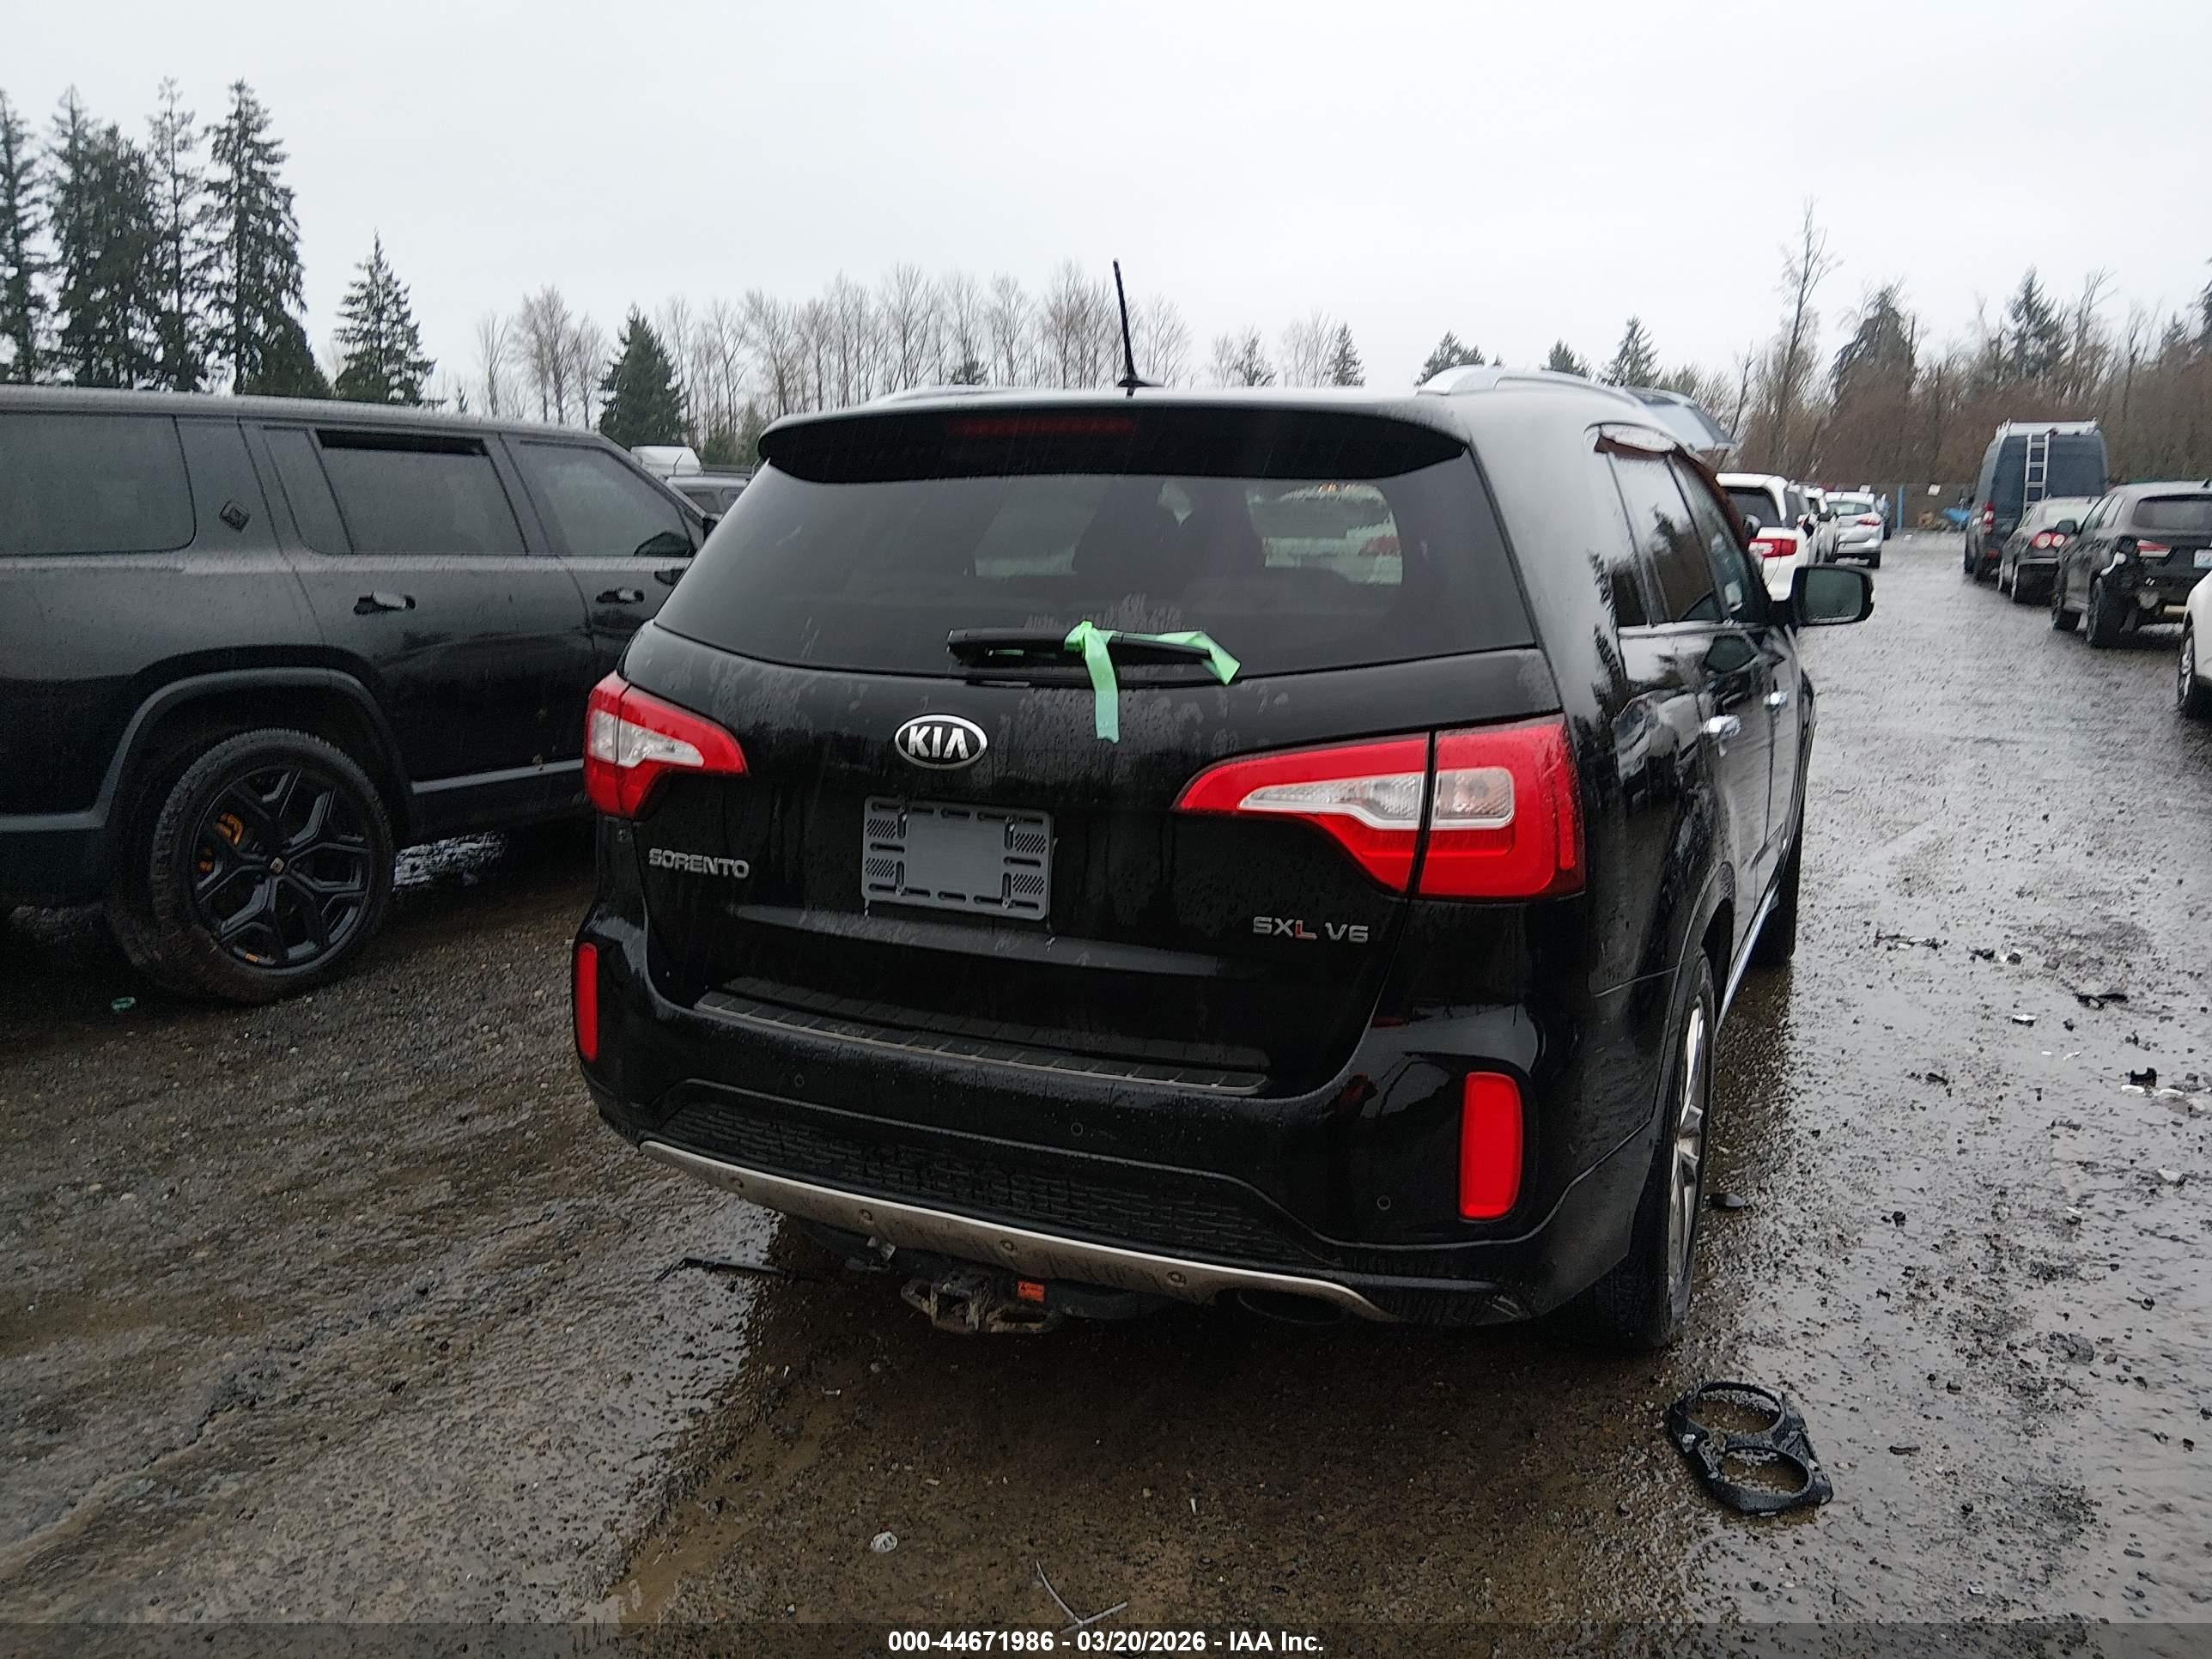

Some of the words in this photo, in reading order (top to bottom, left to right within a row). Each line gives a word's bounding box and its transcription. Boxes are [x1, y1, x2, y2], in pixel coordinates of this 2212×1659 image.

[908, 726, 969, 760] KIA
[648, 848, 750, 878] SORENTO
[1253, 916, 1318, 940] SXL
[1325, 922, 1370, 944] V6
